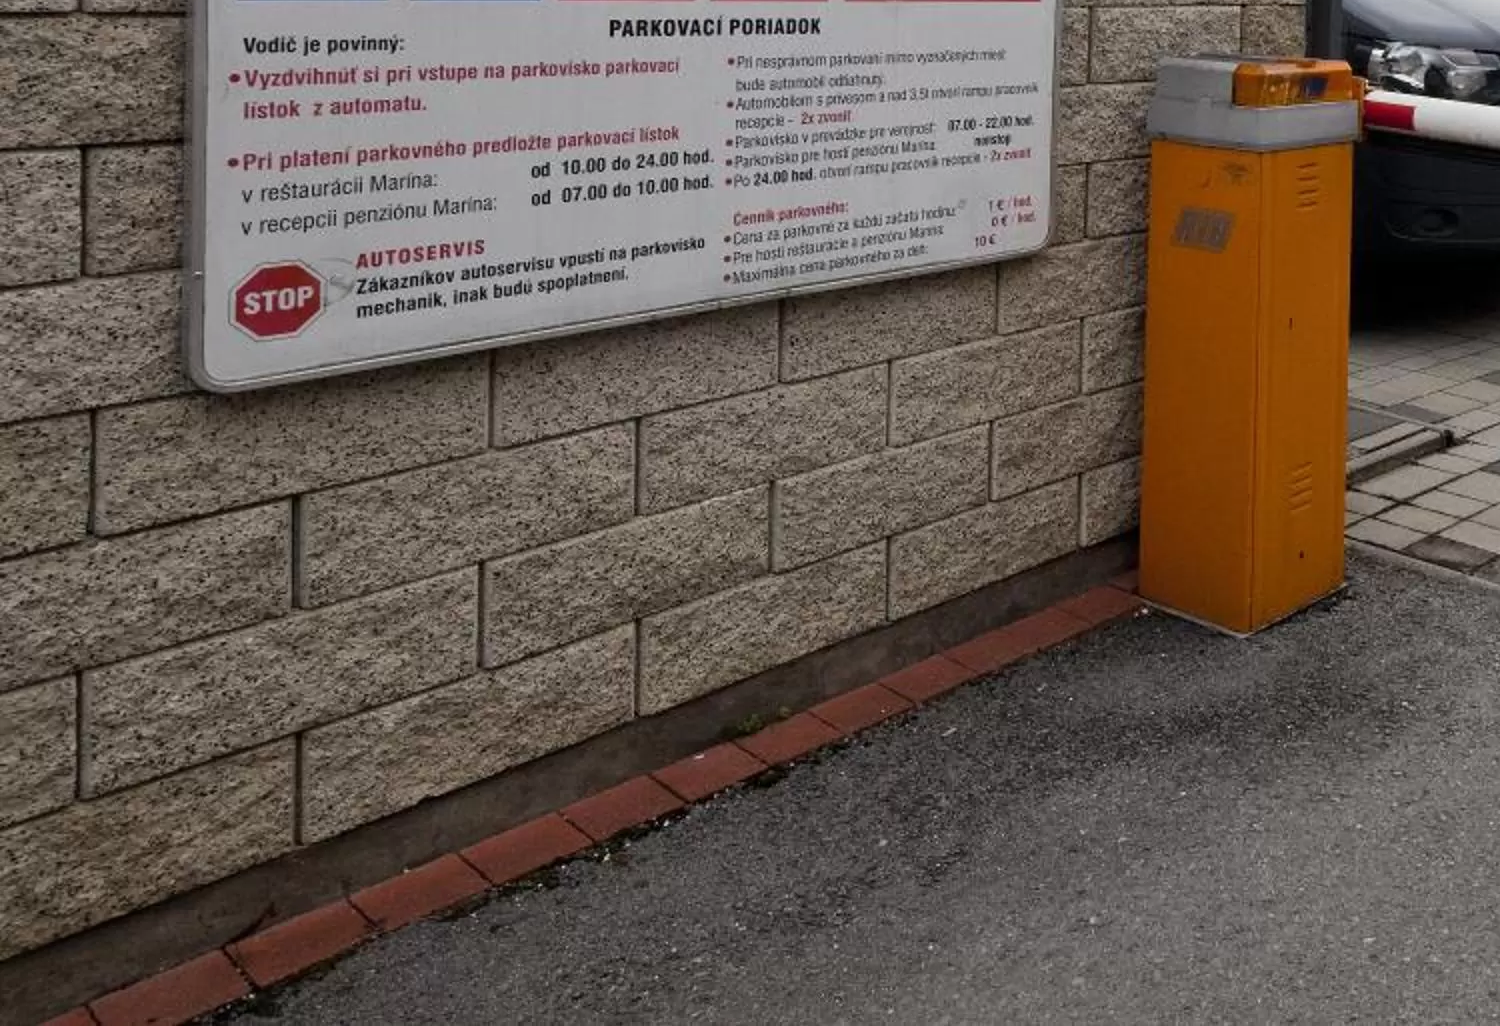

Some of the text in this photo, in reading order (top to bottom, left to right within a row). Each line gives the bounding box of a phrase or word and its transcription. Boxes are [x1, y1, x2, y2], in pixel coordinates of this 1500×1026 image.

[609, 16, 821, 37] PARKOVACÍ PORIADOK
[243, 34, 405, 56] Vodič je povinný:
[245, 56, 680, 90] Vyzdvihnúť si pri vstupe na parkovisko parkovací
[243, 96, 427, 119] lístok z automatu.
[243, 124, 680, 171] Pri platení parkovného predložte parkovací lístok
[531, 149, 715, 179] od 10.00 do 24.00 hod.
[754, 170, 788, 186] 24.00
[242, 190, 253, 203] v
[260, 176, 364, 203] reštaurácii
[531, 176, 715, 207] od 07.00 do 10.00 hod.
[241, 222, 252, 236] v
[260, 210, 338, 238] recepcii
[343, 202, 428, 230] penziónu
[356, 239, 486, 268] AUTOSERVIS
[356, 236, 705, 295] Zákazníkov autoservisu vpustí na parkovisko
[243, 285, 315, 317] STOP
[356, 267, 630, 319] mechanik, inak budú spoplatnení.
